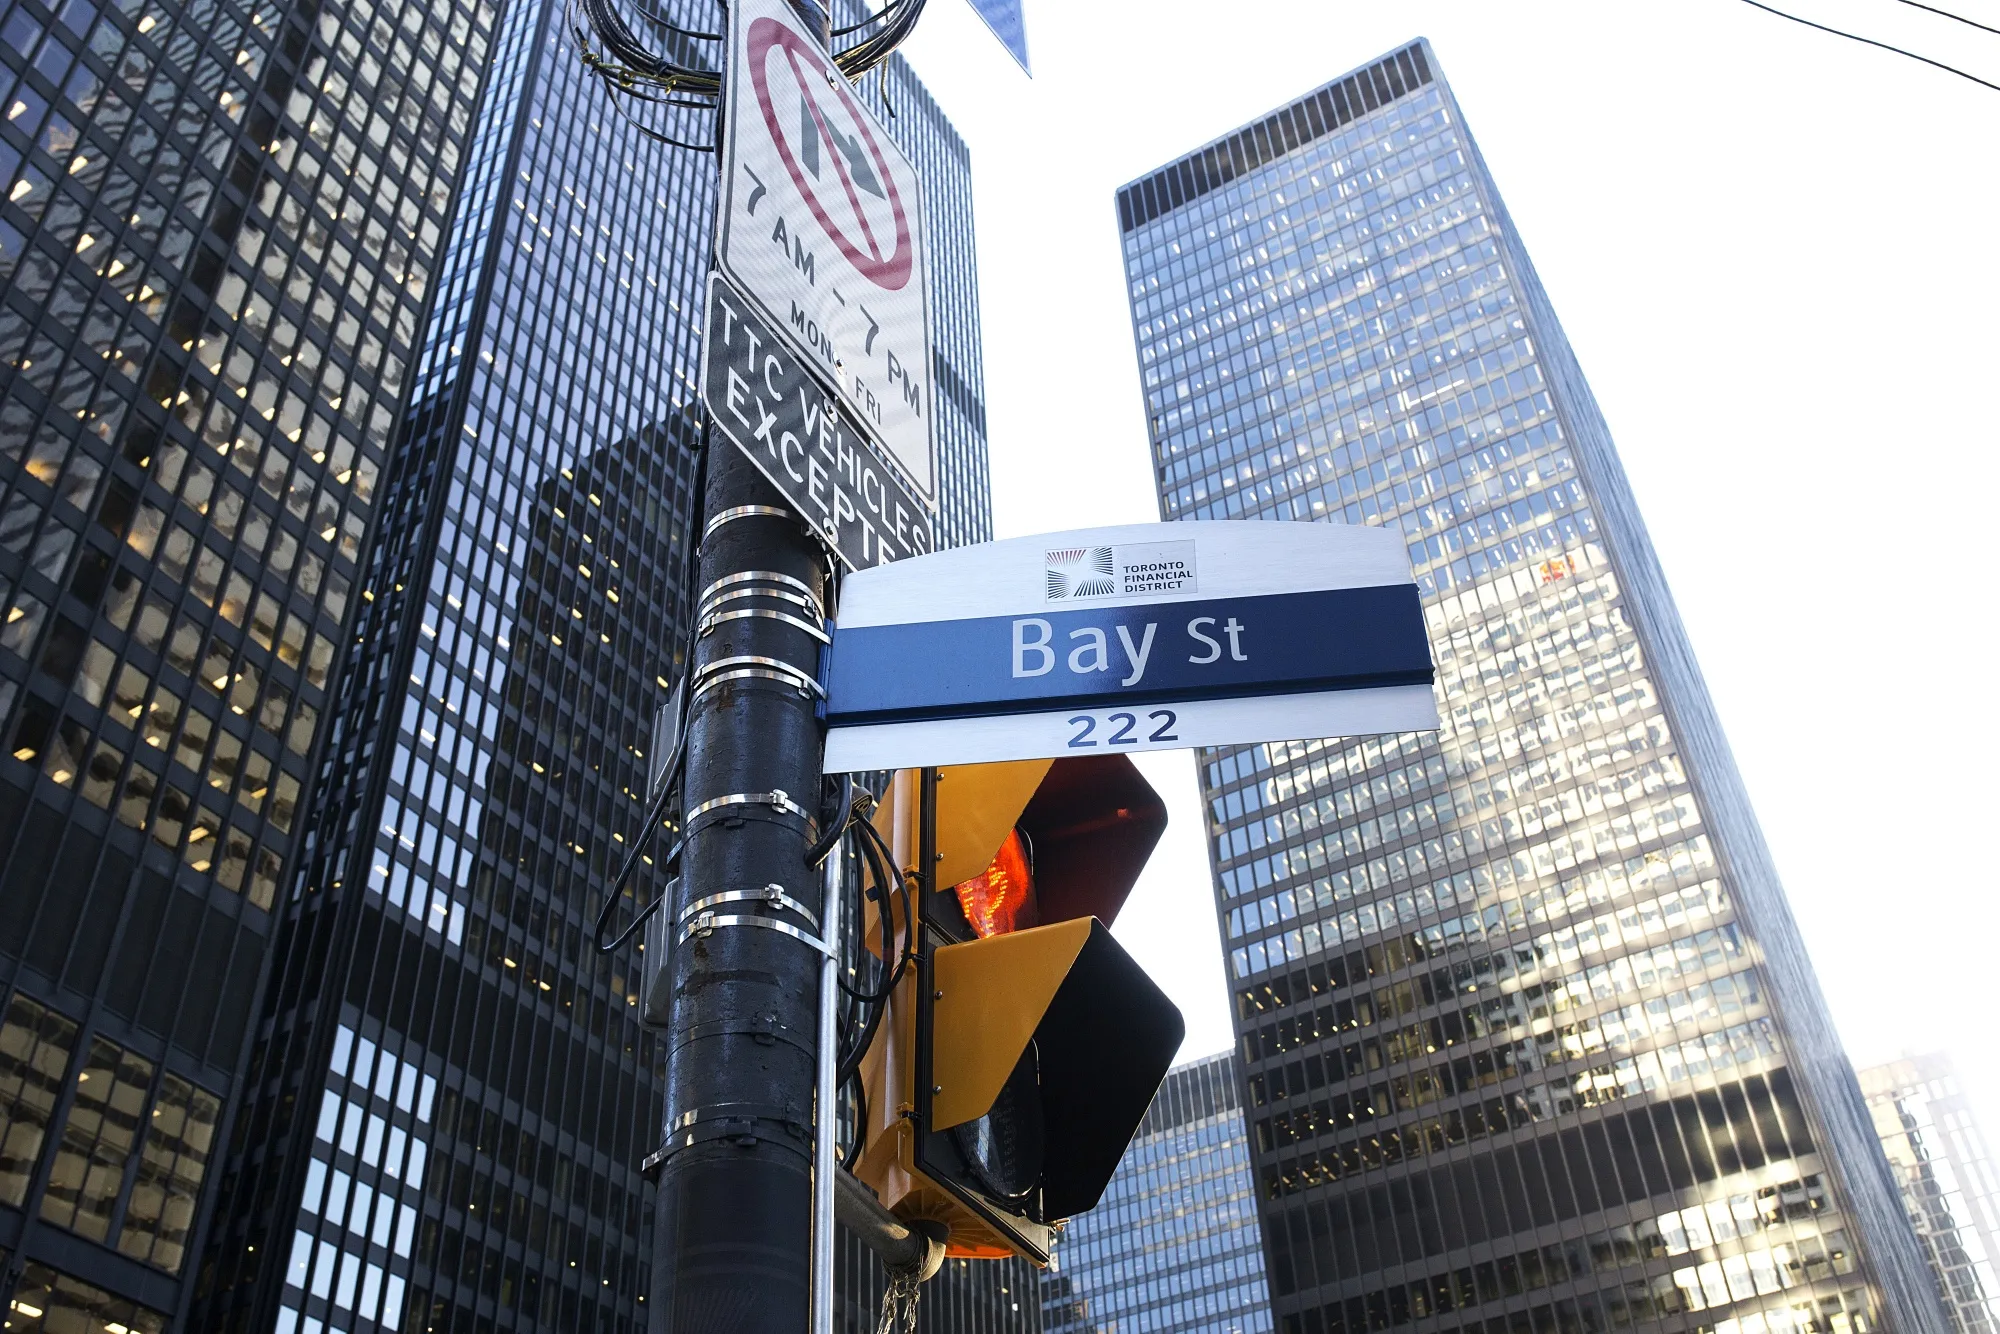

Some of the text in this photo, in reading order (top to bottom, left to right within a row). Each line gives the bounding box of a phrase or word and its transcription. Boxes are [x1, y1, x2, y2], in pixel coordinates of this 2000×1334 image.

[744, 162, 766, 217] 7
[772, 215, 814, 287] AM
[860, 303, 879, 357] 7
[888, 349, 920, 419] PM
[791, 300, 881, 425] MON FRI
[719, 297, 926, 557] TTC VEHICLES
[726, 366, 895, 567] EXCEPTE
[1123, 561, 1184, 574] TORONTO
[1124, 570, 1193, 583] FINANCIAL
[1125, 580, 1183, 593] DISTRICT
[1012, 616, 1248, 687] Bay St
[1067, 709, 1179, 748] 222
